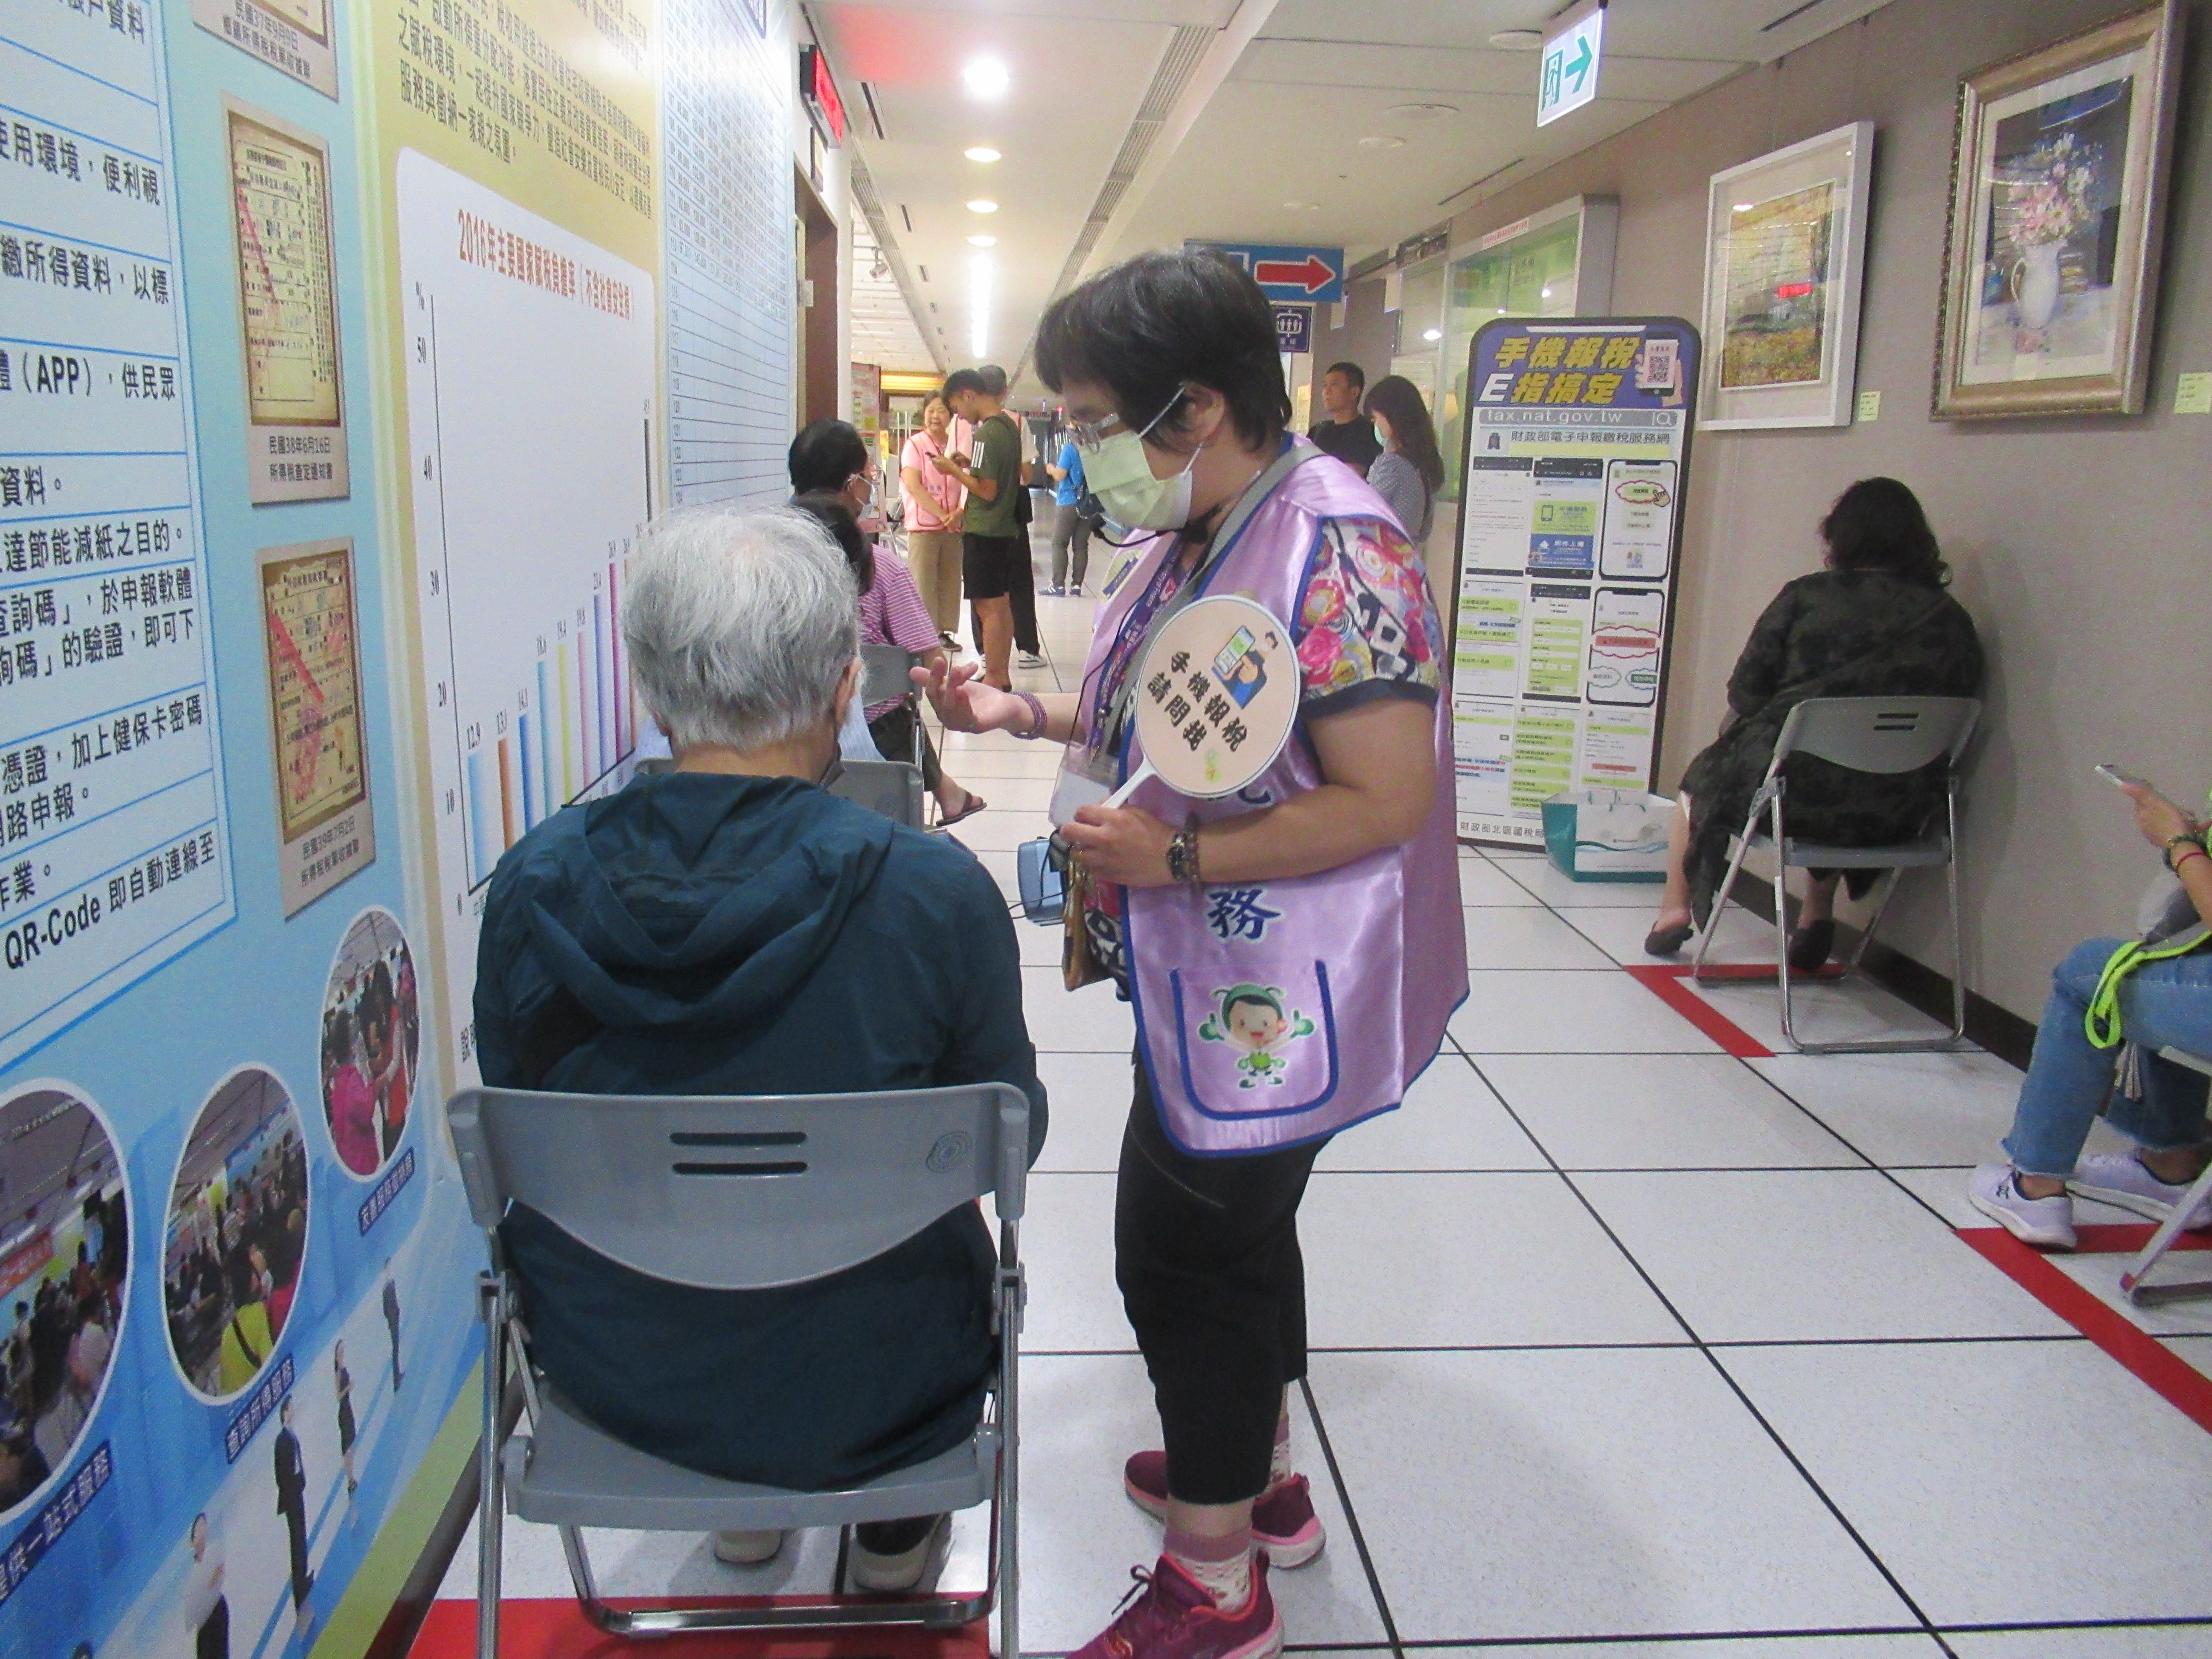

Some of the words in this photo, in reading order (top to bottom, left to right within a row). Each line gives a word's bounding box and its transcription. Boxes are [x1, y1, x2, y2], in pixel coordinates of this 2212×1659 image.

[1495, 337, 1641, 369] 手機報稅
[1479, 373, 1623, 405] E指搞定
[1488, 410, 1622, 423] tax.nat.gov.tw
[1511, 431, 1671, 445] 財政部電子申報繳稅服務網
[430, 570, 439, 596] 30
[438, 681, 447, 707] 20
[1171, 651, 1247, 753] 手機報稅
[2, 693, 203, 795] 憑證，加上健保卡密碼
[467, 722, 481, 750] 12.9
[0, 782, 88, 847] 路申報。
[445, 788, 455, 815] 10
[1460, 821, 1544, 839] 財政部北區國稅局
[5, 894, 101, 970] QR-Code
[109, 831, 215, 913] 即自動連線至
[1208, 888, 1281, 940] 務
